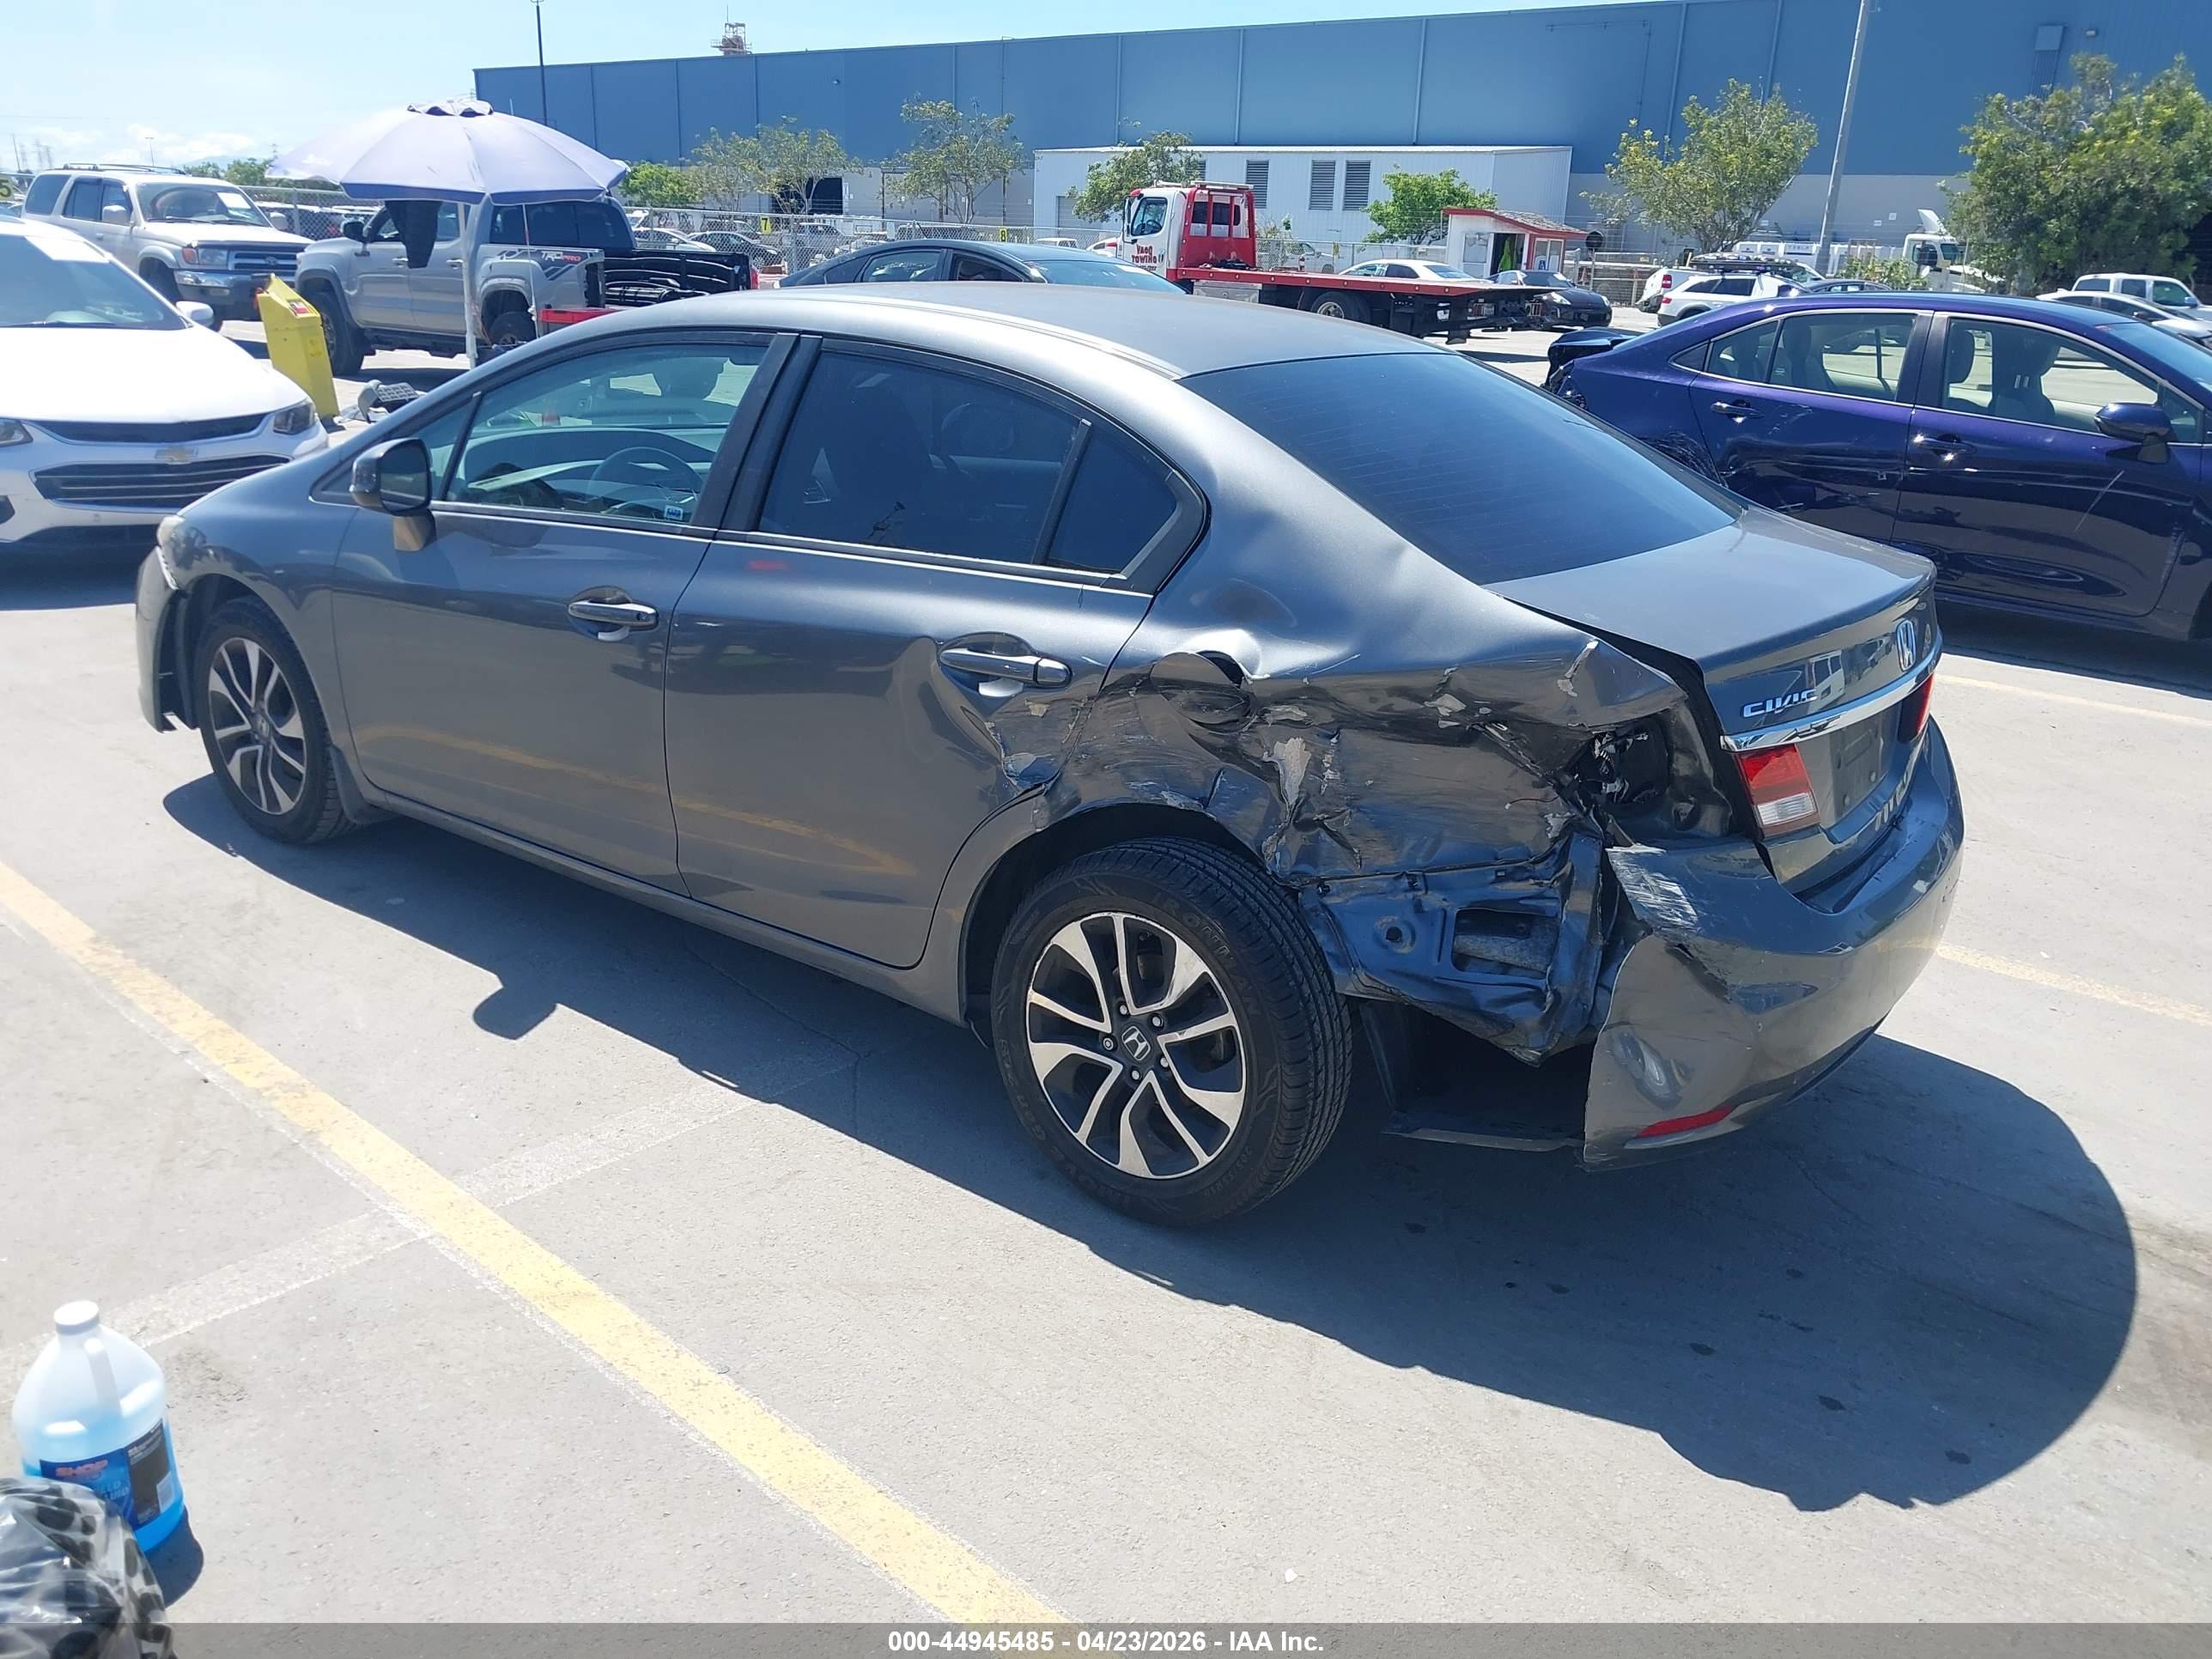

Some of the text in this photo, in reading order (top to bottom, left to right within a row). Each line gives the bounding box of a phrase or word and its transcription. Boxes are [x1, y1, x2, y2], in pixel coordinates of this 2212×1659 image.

[761, 217, 768, 230] 7
[1000, 230, 1006, 242] 8
[1743, 689, 1818, 718] CIVIC
